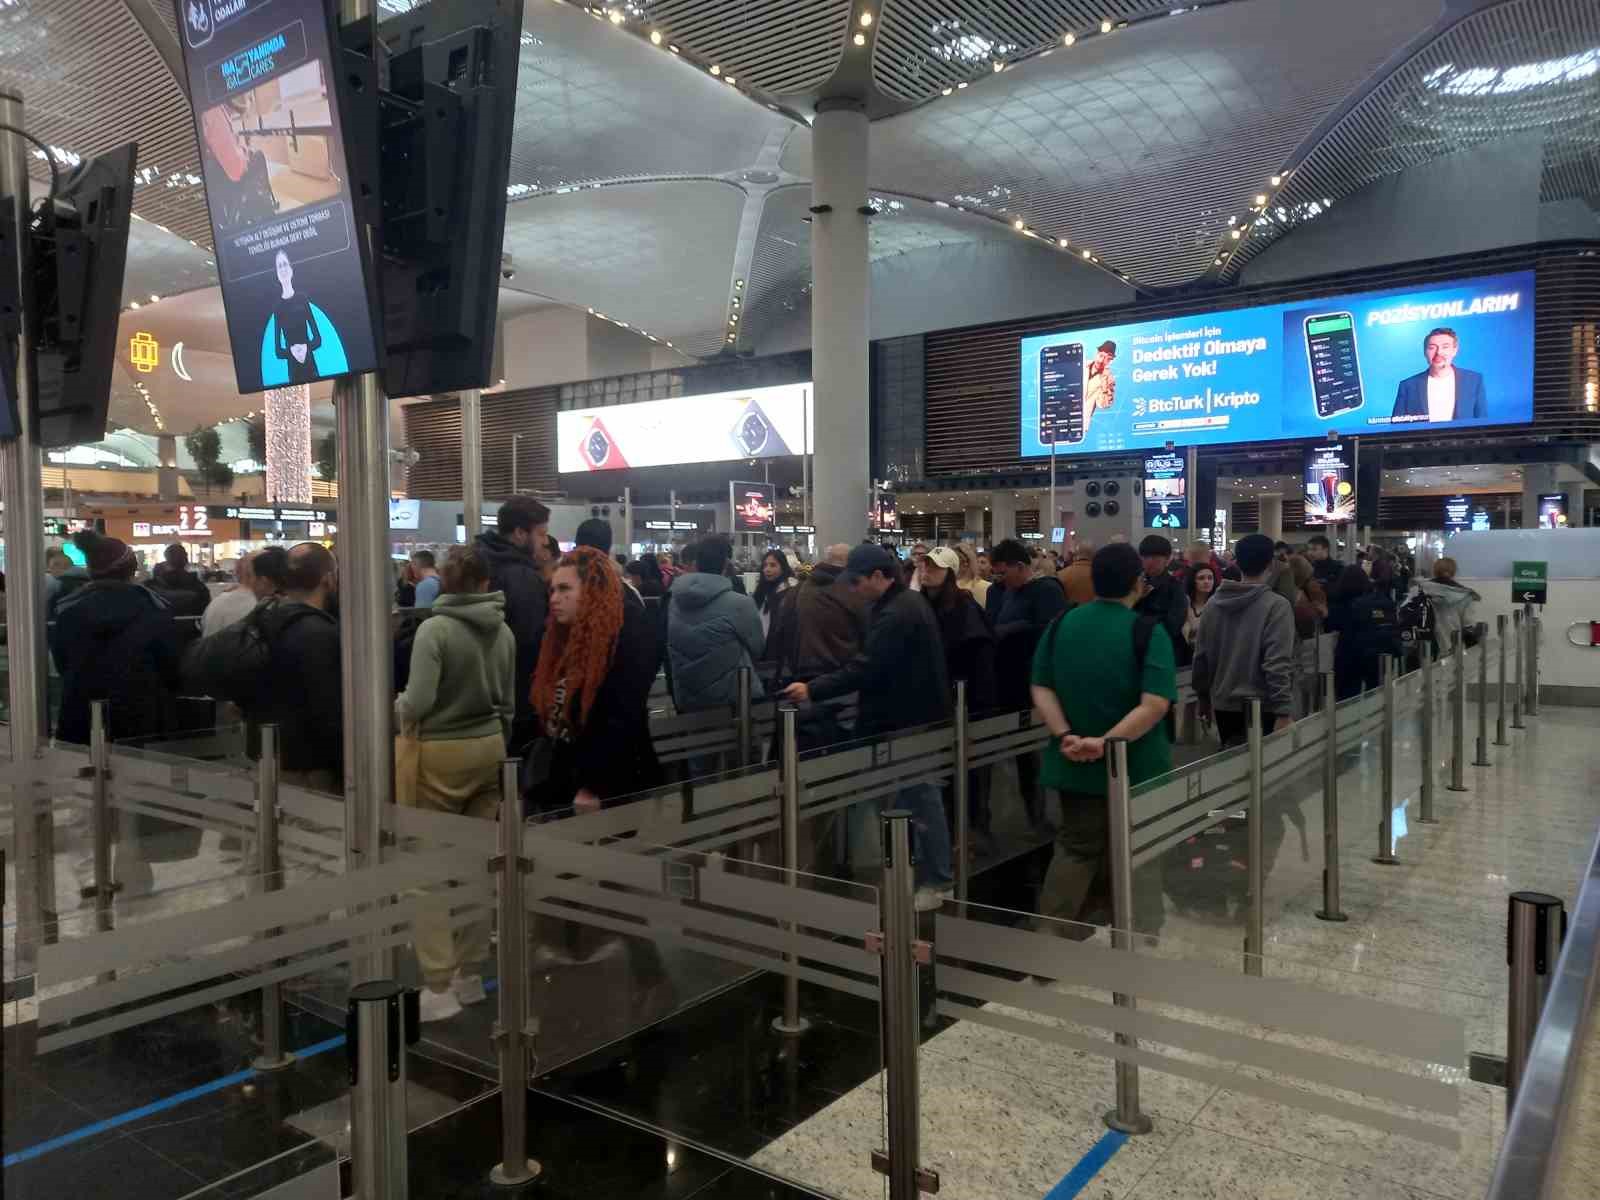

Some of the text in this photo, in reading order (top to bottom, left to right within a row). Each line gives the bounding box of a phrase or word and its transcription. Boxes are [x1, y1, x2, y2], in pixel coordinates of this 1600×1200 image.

[1132, 337, 1267, 364] Dedektif Olmaya
[1132, 360, 1217, 383] Gerek Yok!
[1213, 391, 1260, 409] Kripto
